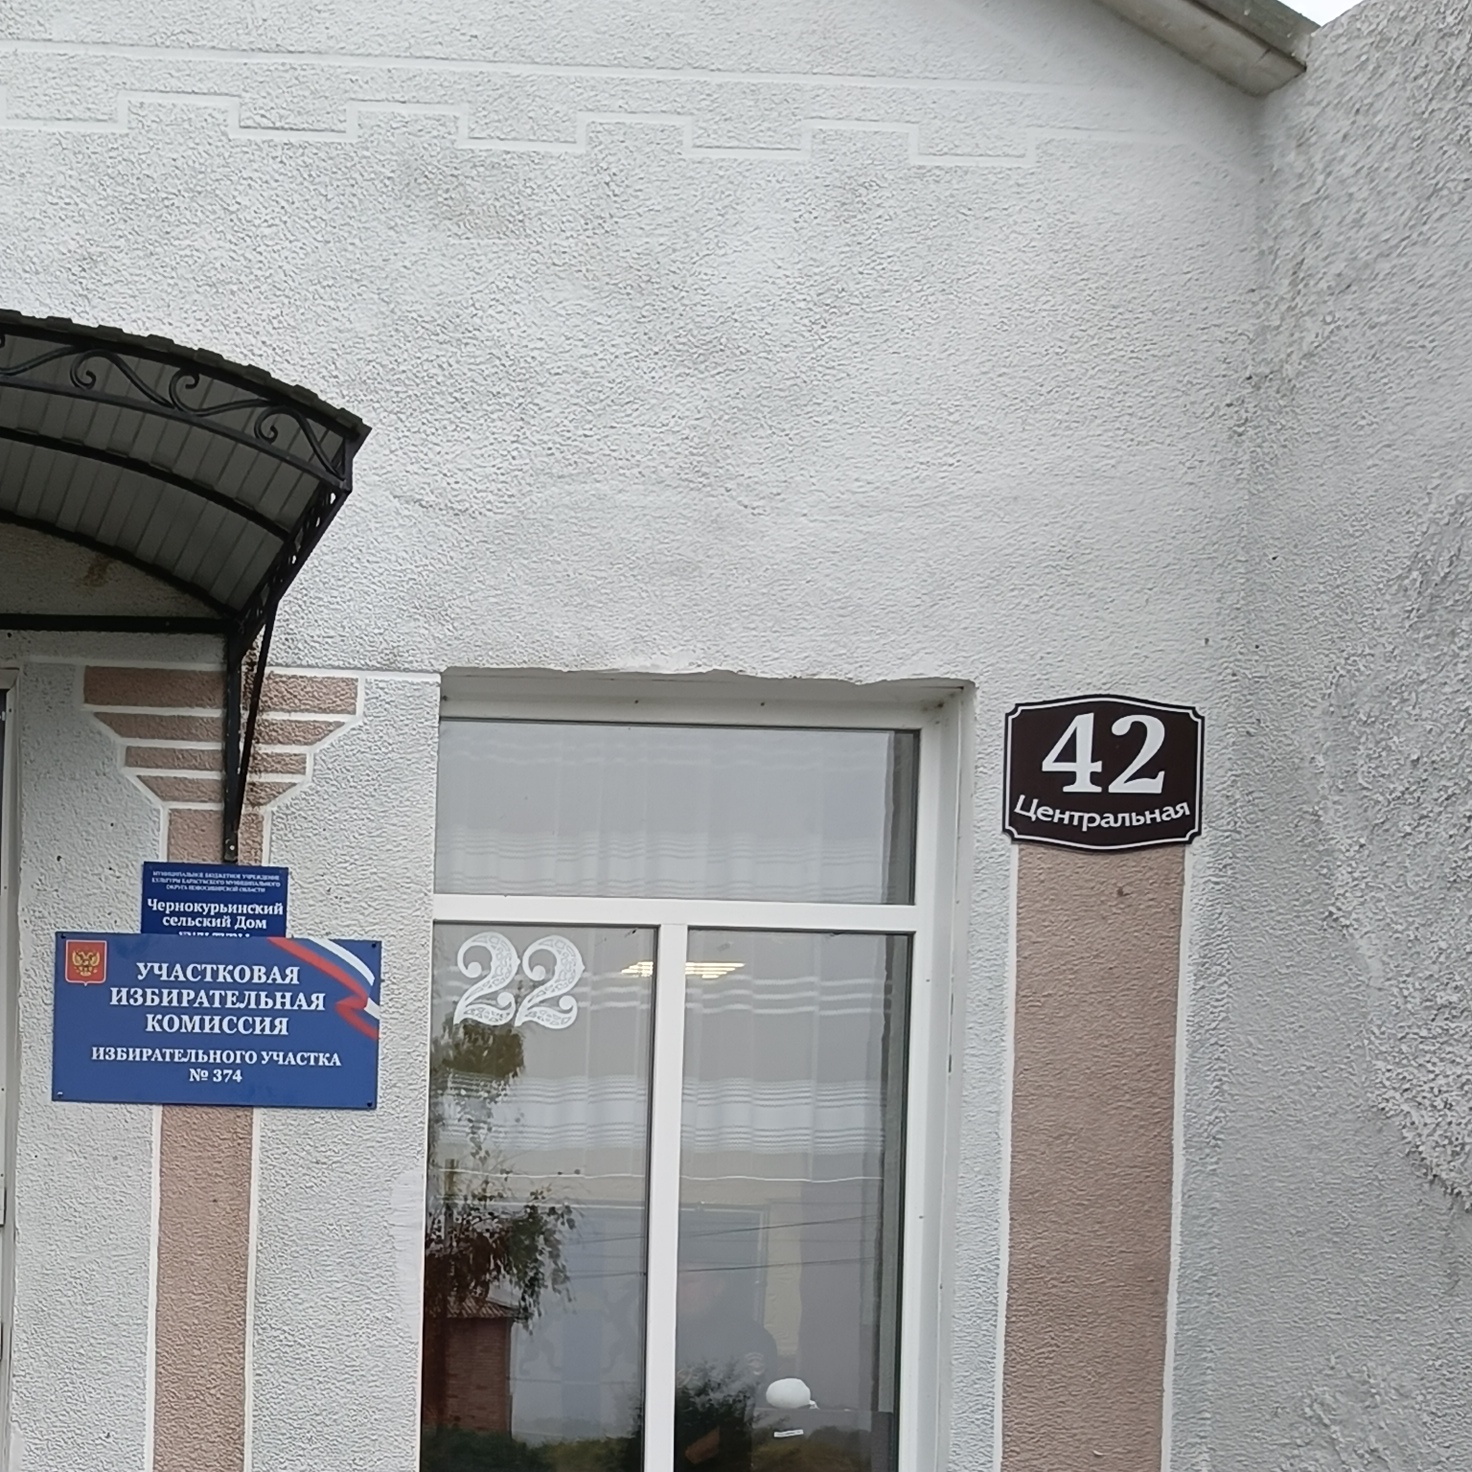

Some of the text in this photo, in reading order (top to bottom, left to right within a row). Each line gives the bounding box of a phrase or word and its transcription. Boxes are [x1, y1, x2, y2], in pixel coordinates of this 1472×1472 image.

[1042, 713, 1165, 794] 42
[1014, 795, 1190, 831] Центральная
[148, 899, 284, 915] Чернокурьинский
[162, 915, 267, 930] сельский Дом
[136, 961, 300, 985] УЧАСТКОВАЯ
[453, 931, 586, 1030] 22
[110, 987, 326, 1011] ИЗБИРАТЕЛЬНАЯ
[145, 1013, 289, 1036] КОМИССИЯ
[91, 1047, 342, 1067] ИЗБИРАТЕЛЬНОГО УЧАСТКА
[189, 1069, 243, 1083] № 374
